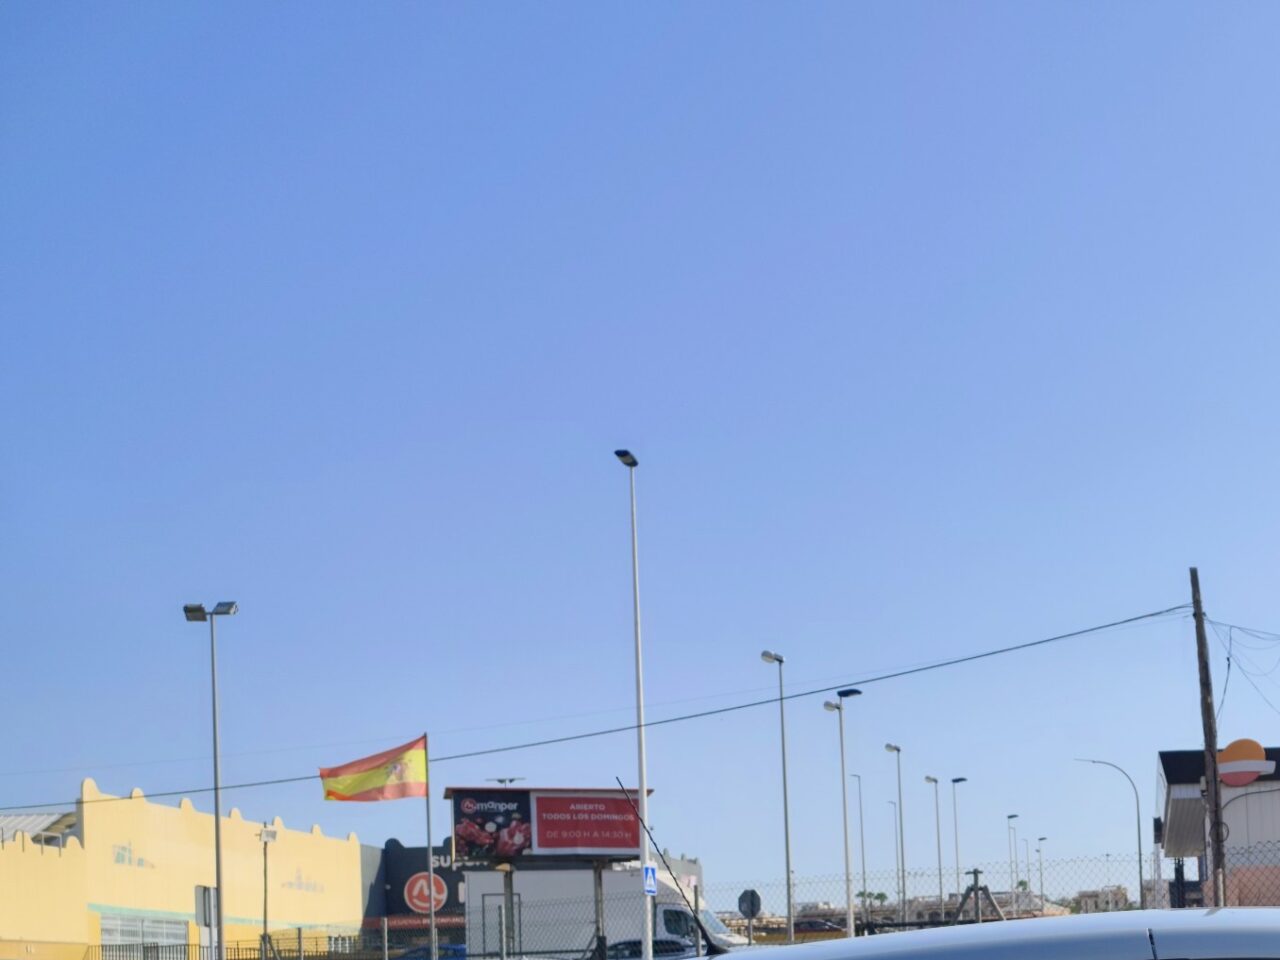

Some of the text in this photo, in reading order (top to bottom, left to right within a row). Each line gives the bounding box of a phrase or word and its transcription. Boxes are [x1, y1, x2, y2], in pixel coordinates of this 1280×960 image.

[475, 802, 518, 812] manper
[542, 813, 634, 821] TODOS LOS DOMINGOS
